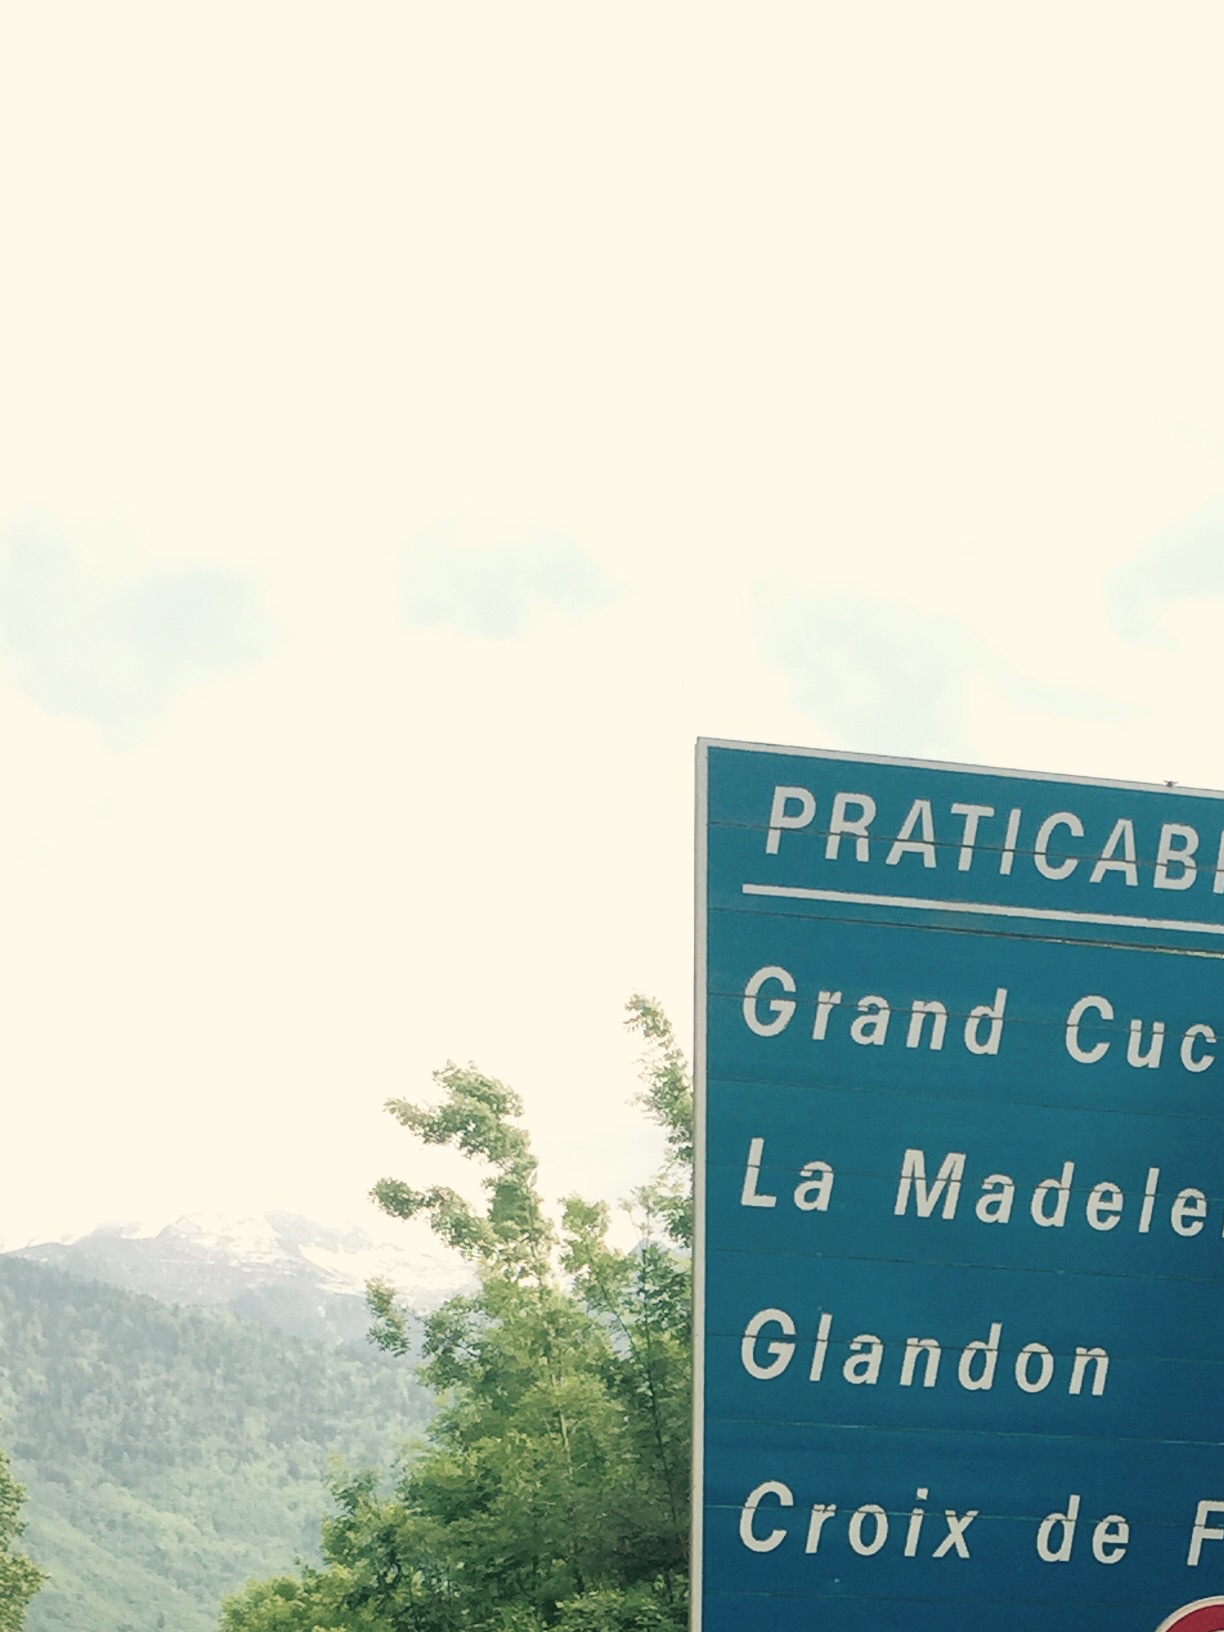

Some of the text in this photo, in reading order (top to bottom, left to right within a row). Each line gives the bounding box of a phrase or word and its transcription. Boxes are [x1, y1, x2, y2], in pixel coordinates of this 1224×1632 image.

[744, 967, 1006, 1054] Grand
[742, 1138, 833, 1210] La
[742, 1309, 1108, 1395] Glandon
[740, 1481, 977, 1557] Croix
[1038, 1495, 1128, 1563] de
